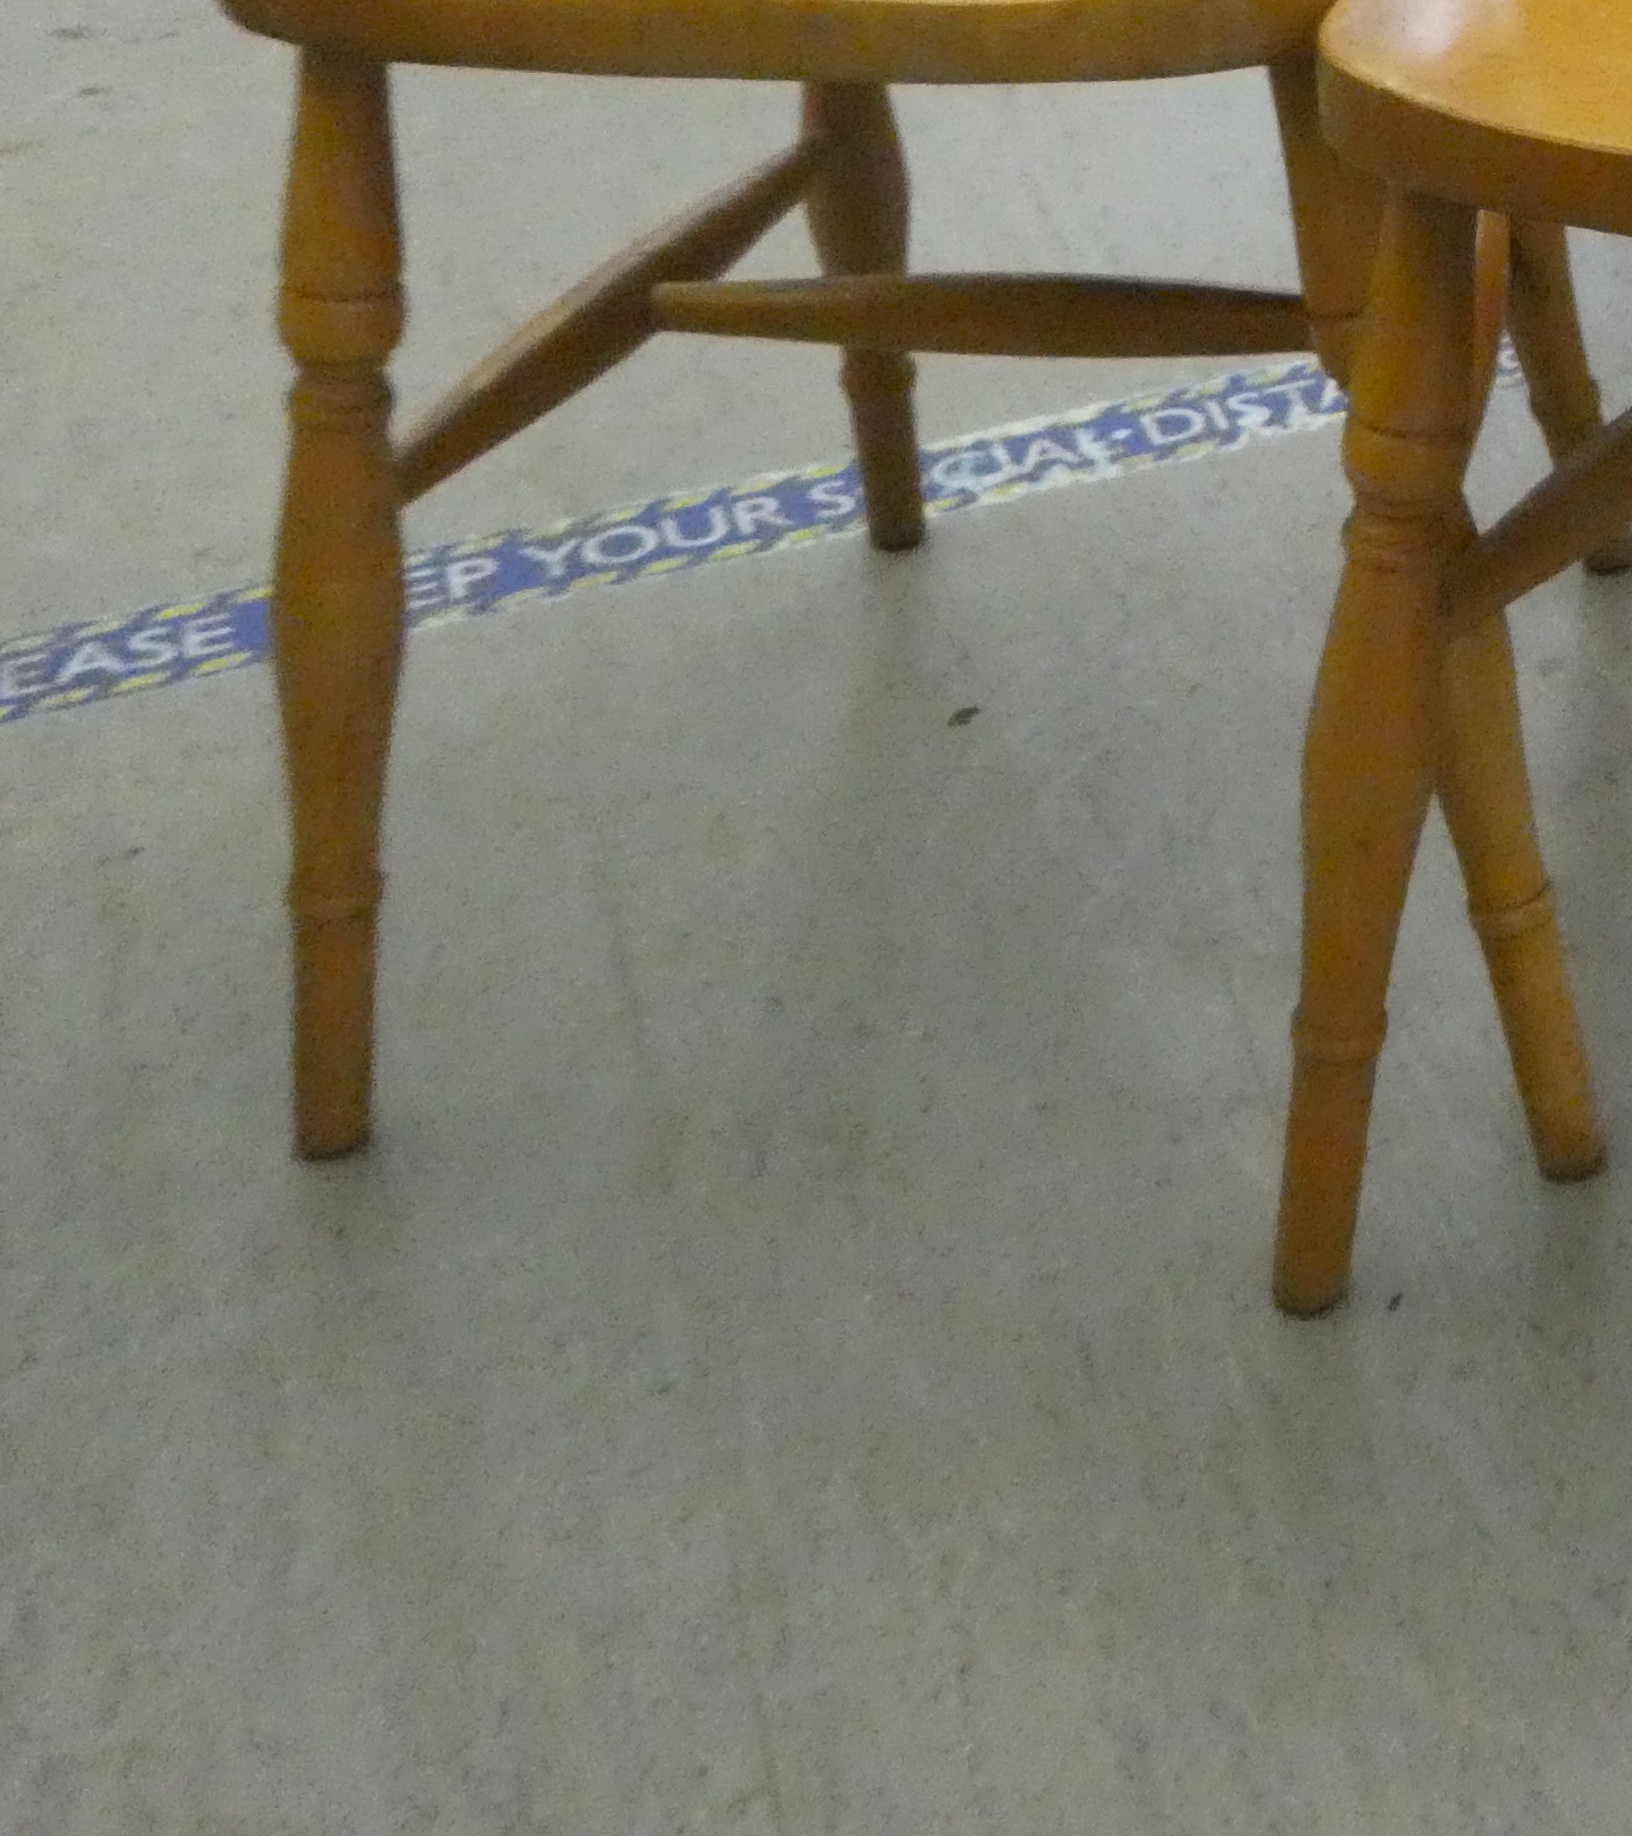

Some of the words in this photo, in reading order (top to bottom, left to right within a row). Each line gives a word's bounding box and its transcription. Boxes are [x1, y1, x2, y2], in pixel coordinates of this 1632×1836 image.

[406, 556, 499, 608] EP
[520, 497, 795, 577] YOUR
[807, 428, 1129, 518] SCIAL
